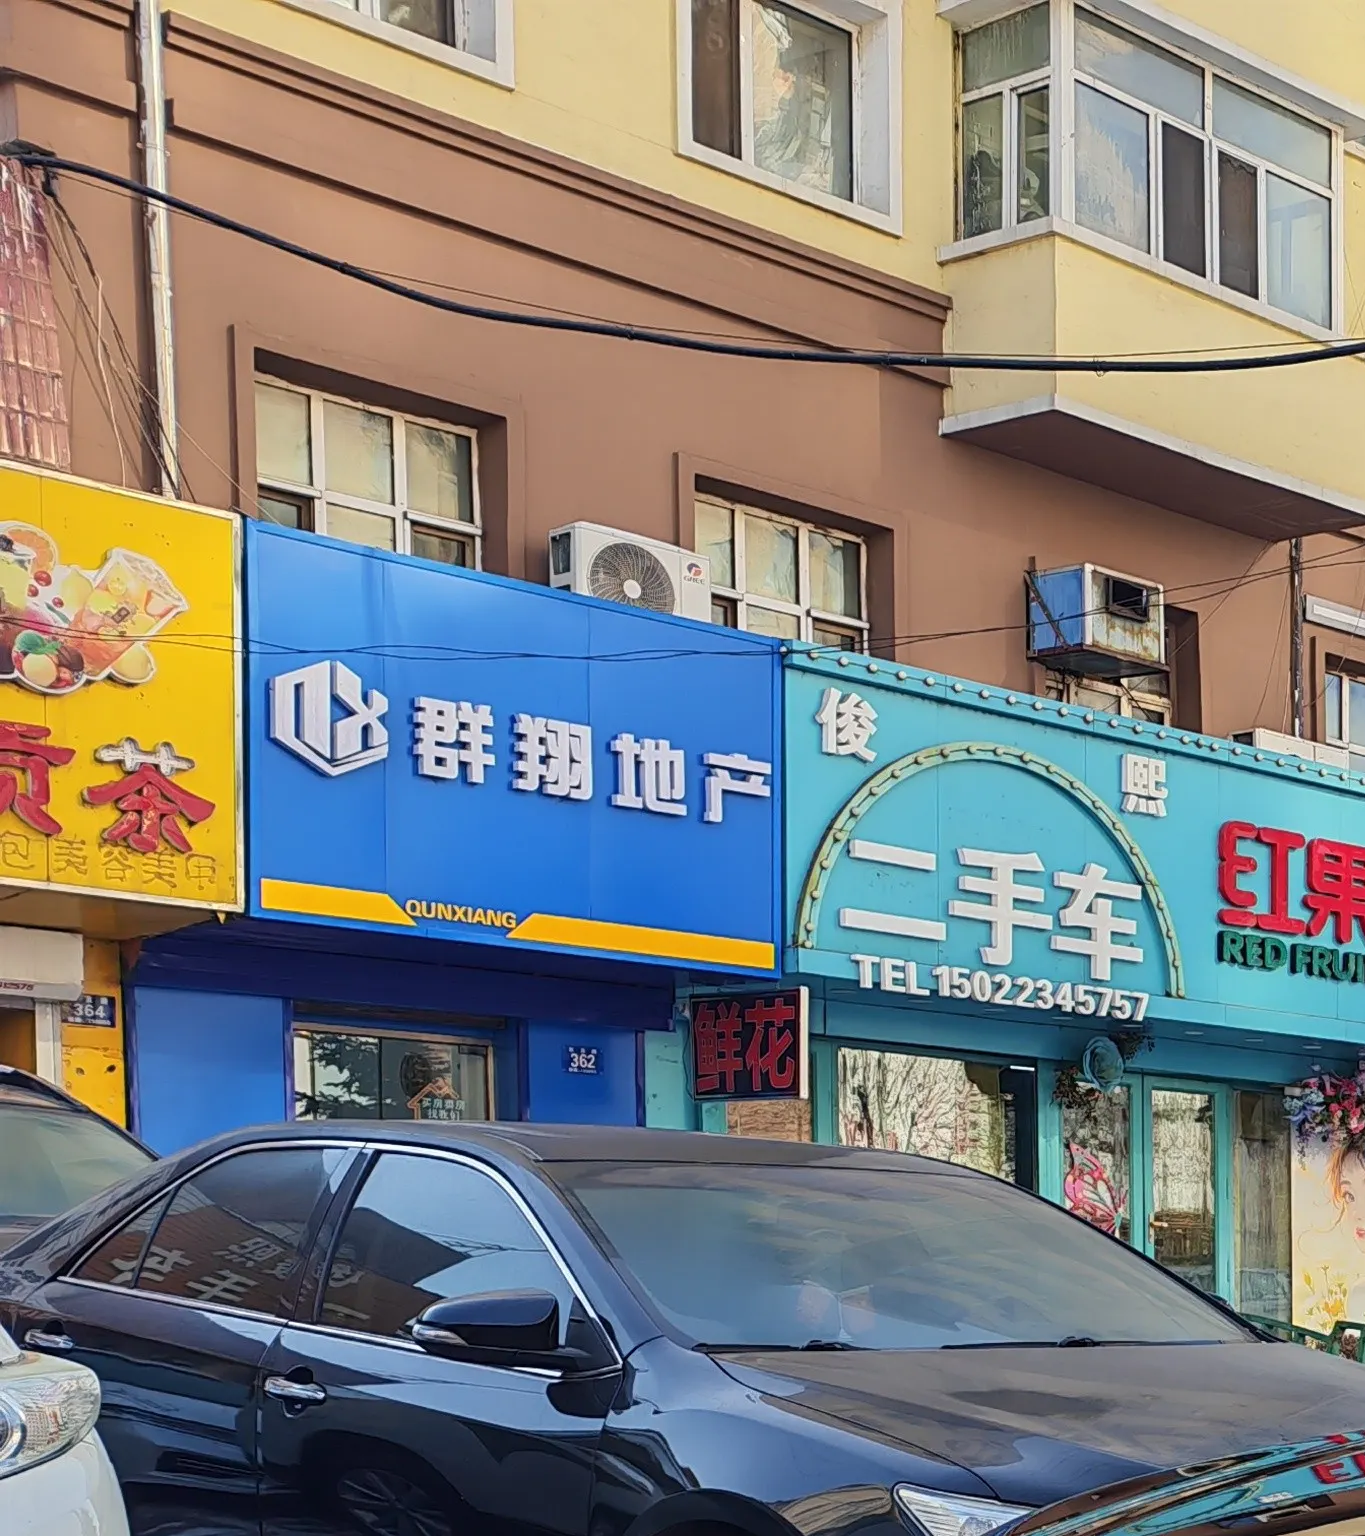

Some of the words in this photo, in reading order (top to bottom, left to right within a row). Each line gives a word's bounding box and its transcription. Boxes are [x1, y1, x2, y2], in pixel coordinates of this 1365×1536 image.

[414, 697, 771, 822] 群翔地产
[405, 900, 517, 928] QUNXIANG
[840, 839, 1143, 981] 二手车
[1217, 930, 1287, 971] RED
[73, 1003, 107, 1018] 364
[851, 954, 930, 996] TEL
[932, 965, 1149, 1021] 15022345757
[570, 1053, 596, 1068] 362
[695, 998, 795, 1092] 鲜花
